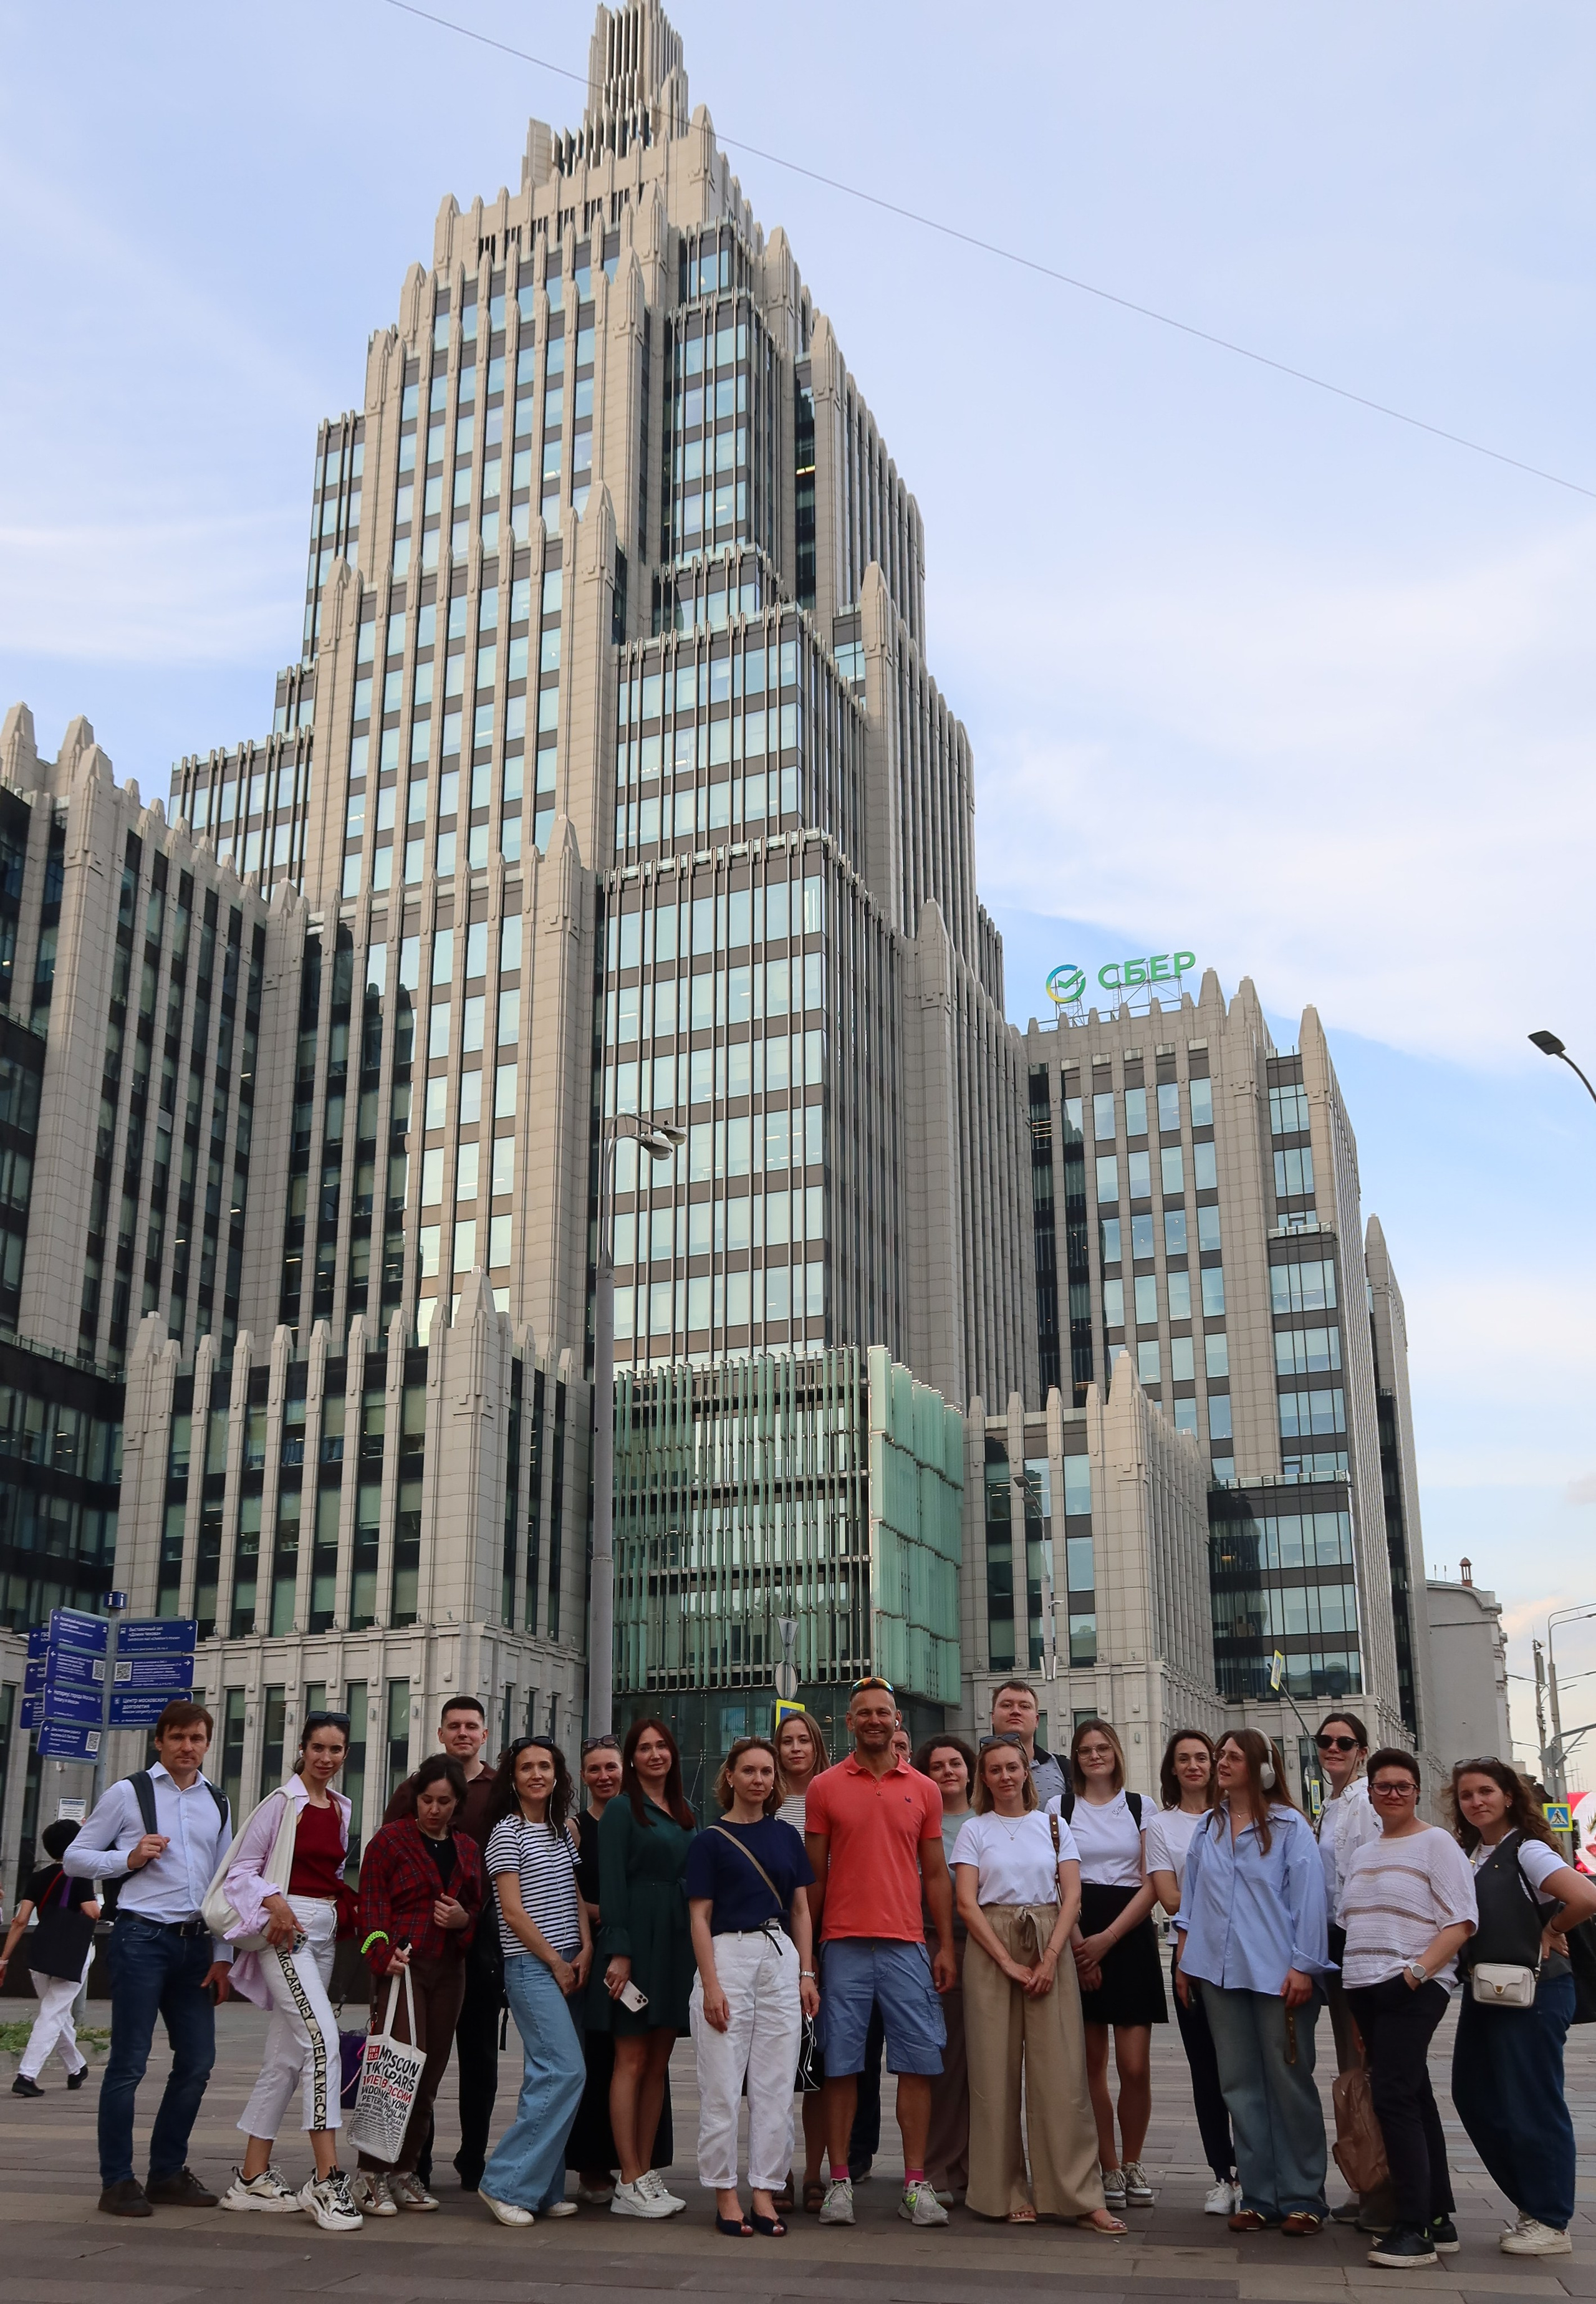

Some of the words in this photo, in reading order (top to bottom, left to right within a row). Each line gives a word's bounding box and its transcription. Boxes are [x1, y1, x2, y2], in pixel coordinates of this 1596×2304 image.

[1098, 951, 1196, 989] СБЕР
[278, 1951, 315, 2020] McCARTNEY
[312, 2031, 327, 2078] STELLA
[392, 2098, 410, 2113] YORK
